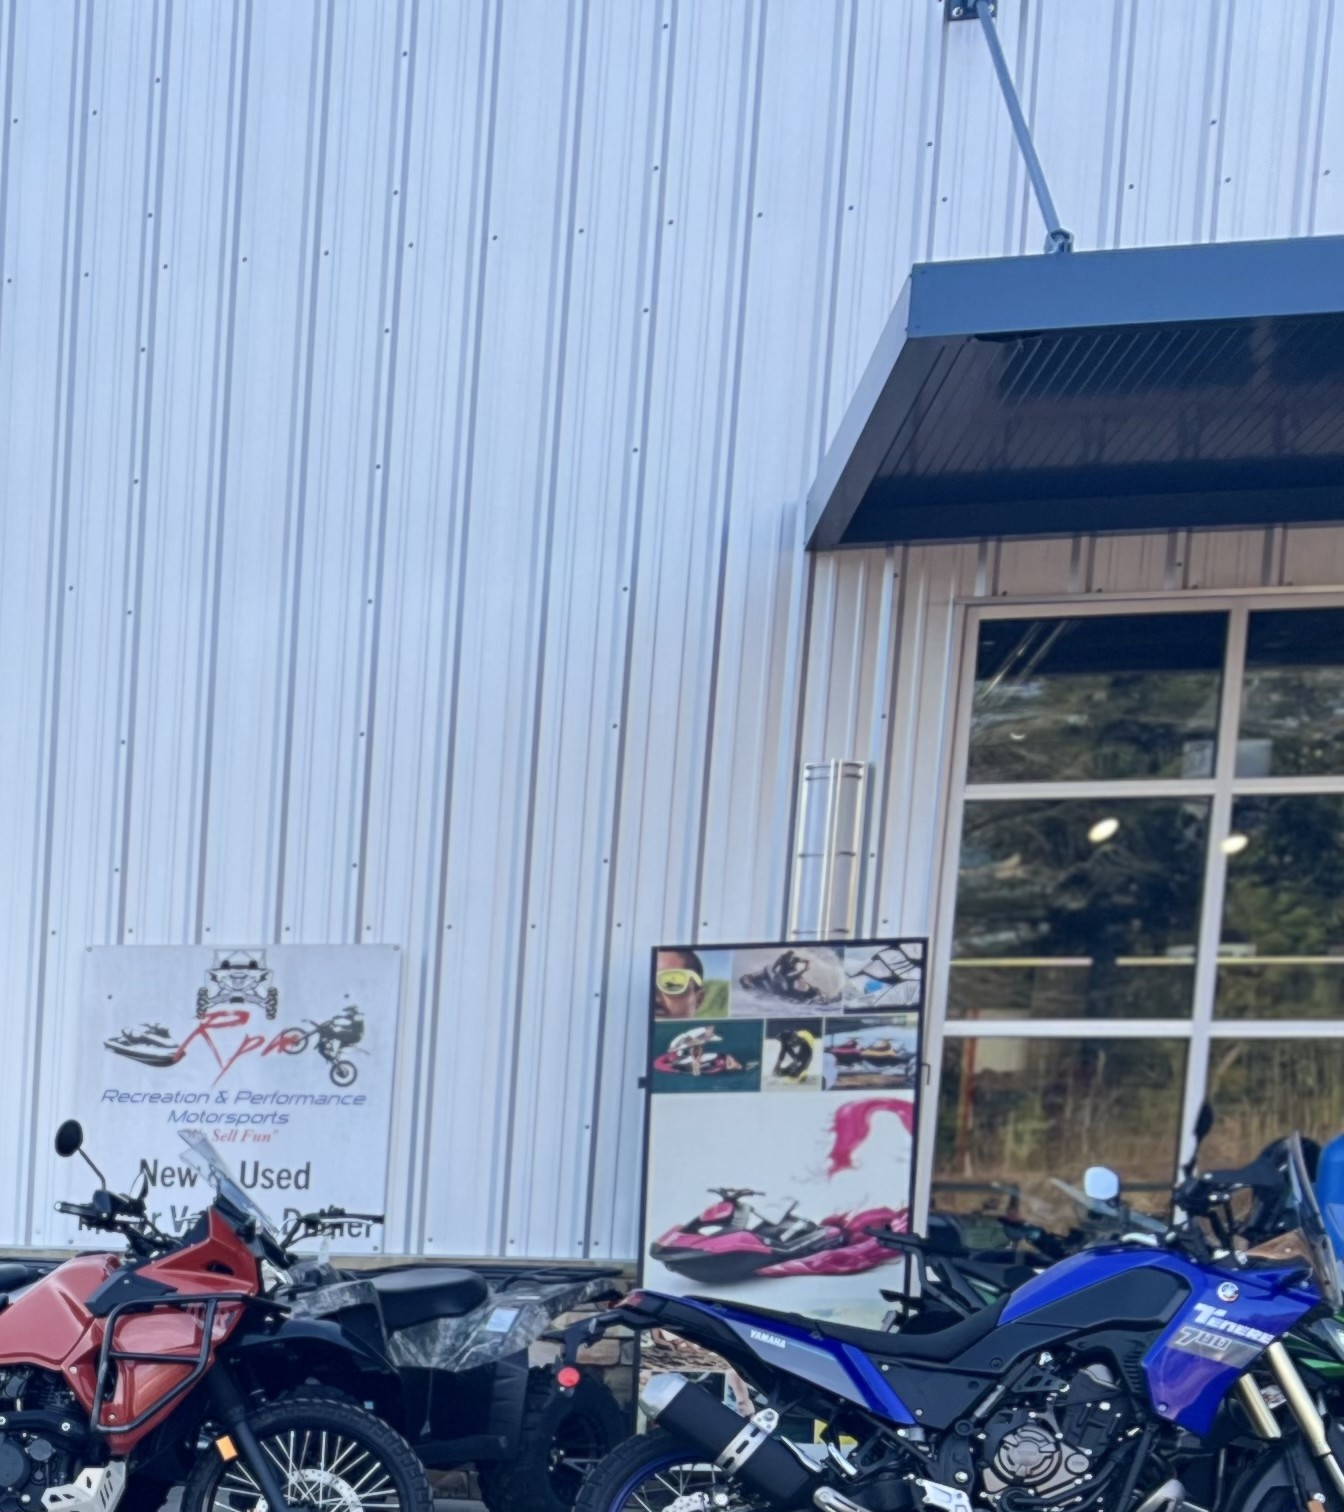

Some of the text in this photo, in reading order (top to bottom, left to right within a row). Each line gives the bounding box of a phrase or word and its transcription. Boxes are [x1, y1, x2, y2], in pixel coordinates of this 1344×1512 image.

[100, 1088, 367, 1106] Recreation & Performance
[167, 1108, 290, 1126] Motorsports
[212, 1129, 238, 1142] Sell
[240, 1129, 280, 1143] Fun"
[139, 1159, 201, 1188] New
[238, 1160, 311, 1190] Used
[749, 1328, 787, 1350] YAMAHA
[1174, 1325, 1234, 1352] 700
